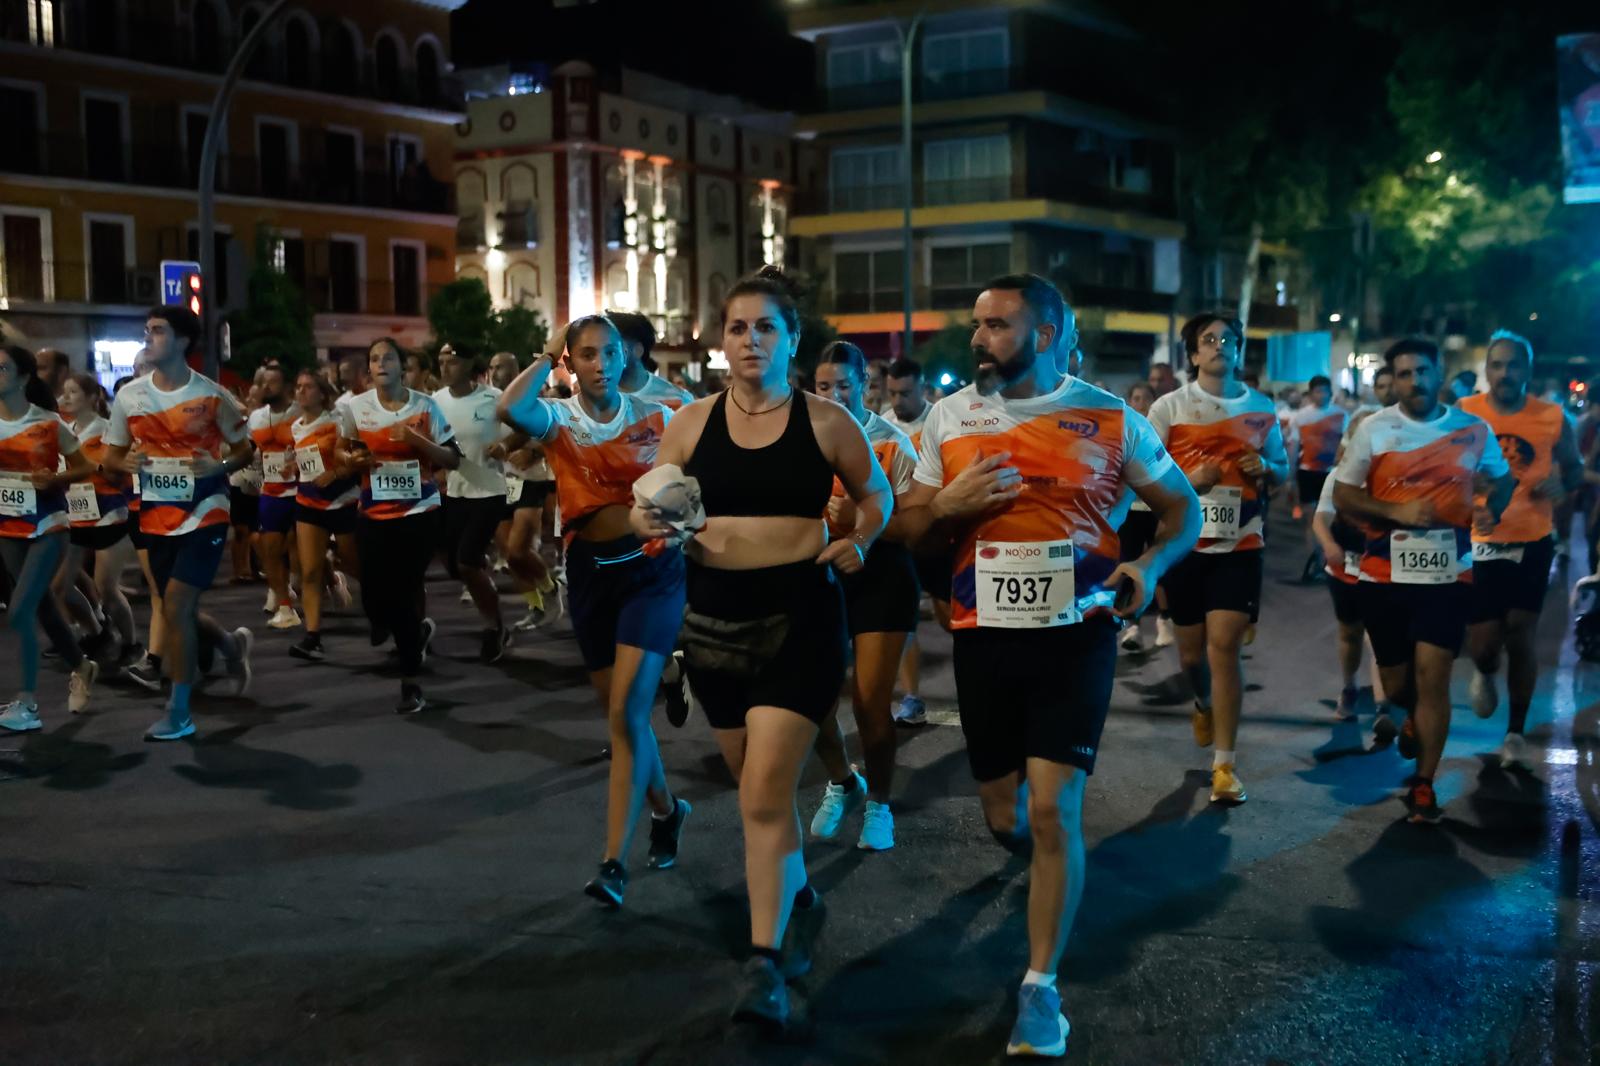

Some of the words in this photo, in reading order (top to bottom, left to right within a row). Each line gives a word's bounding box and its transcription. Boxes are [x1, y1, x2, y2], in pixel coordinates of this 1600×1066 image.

[148, 475, 188, 489] 16845
[376, 476, 415, 489] 11995
[0, 488, 24, 505] 648
[1399, 552, 1449, 569] 13640
[992, 577, 1053, 604] 7937
